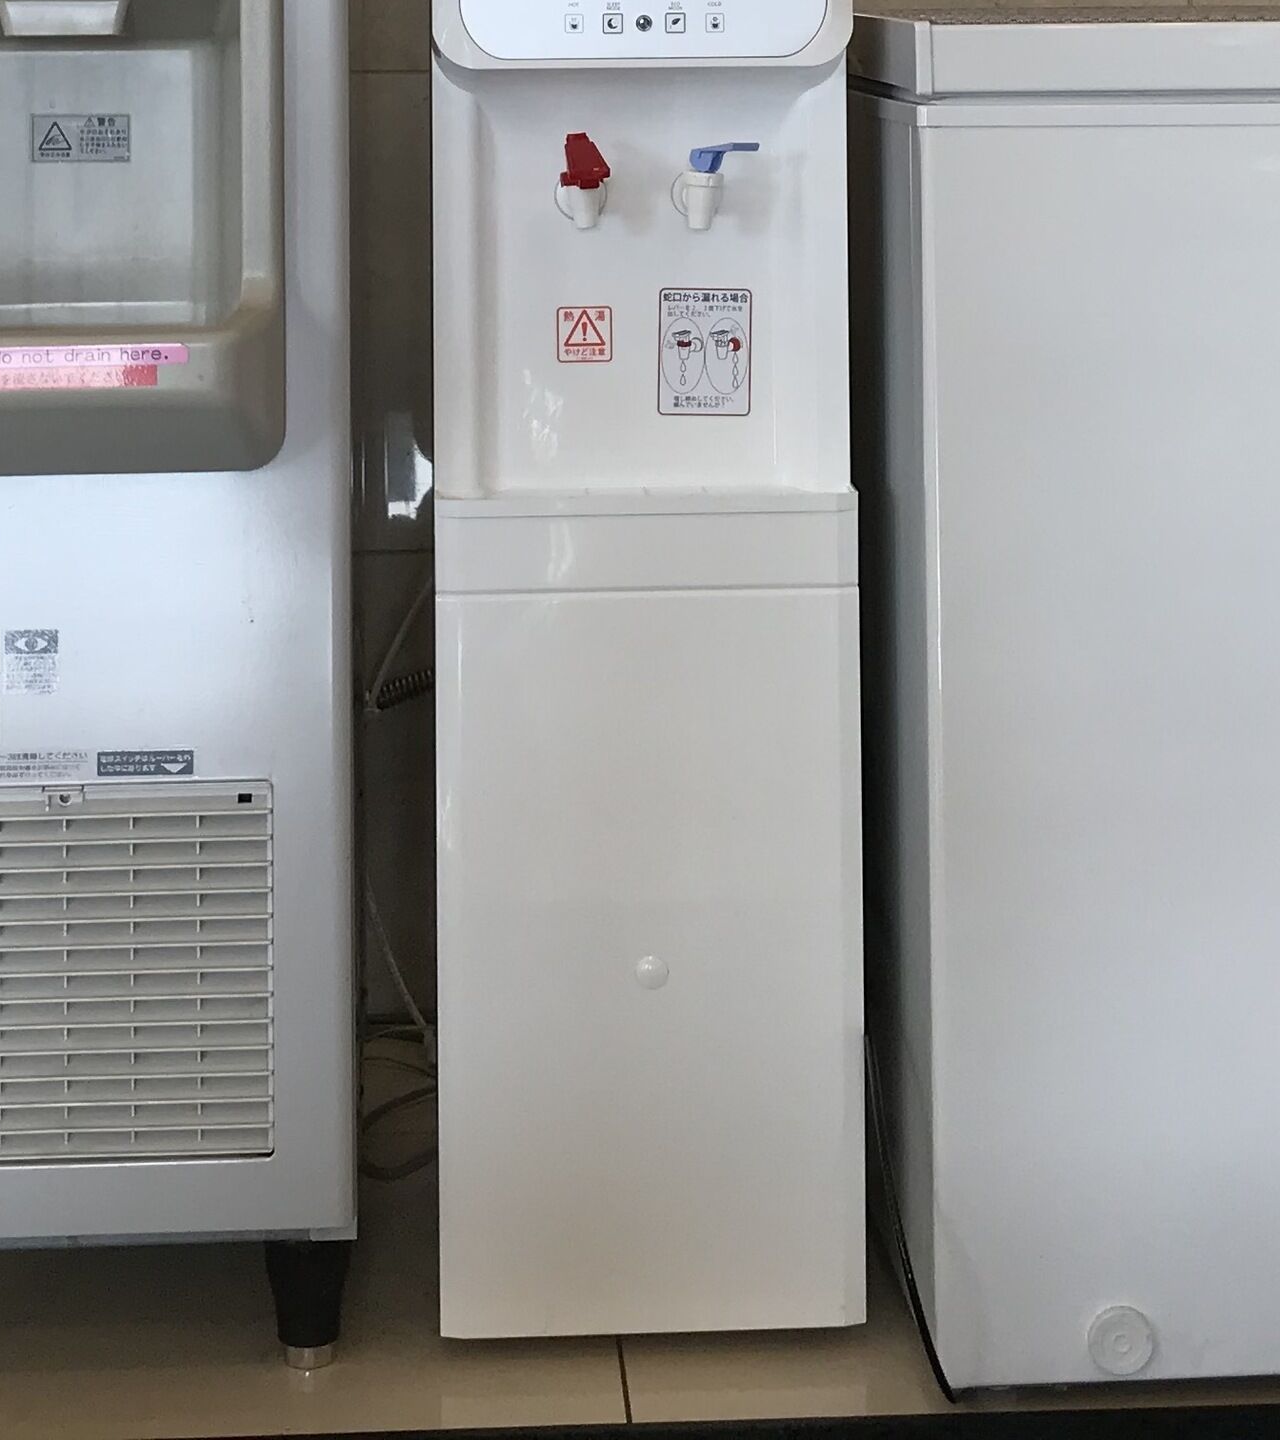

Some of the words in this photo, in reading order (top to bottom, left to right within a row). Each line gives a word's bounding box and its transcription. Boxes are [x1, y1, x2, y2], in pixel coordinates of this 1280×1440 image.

[22, 350, 53, 364] not
[65, 348, 111, 363] drain
[119, 347, 169, 362] here.
